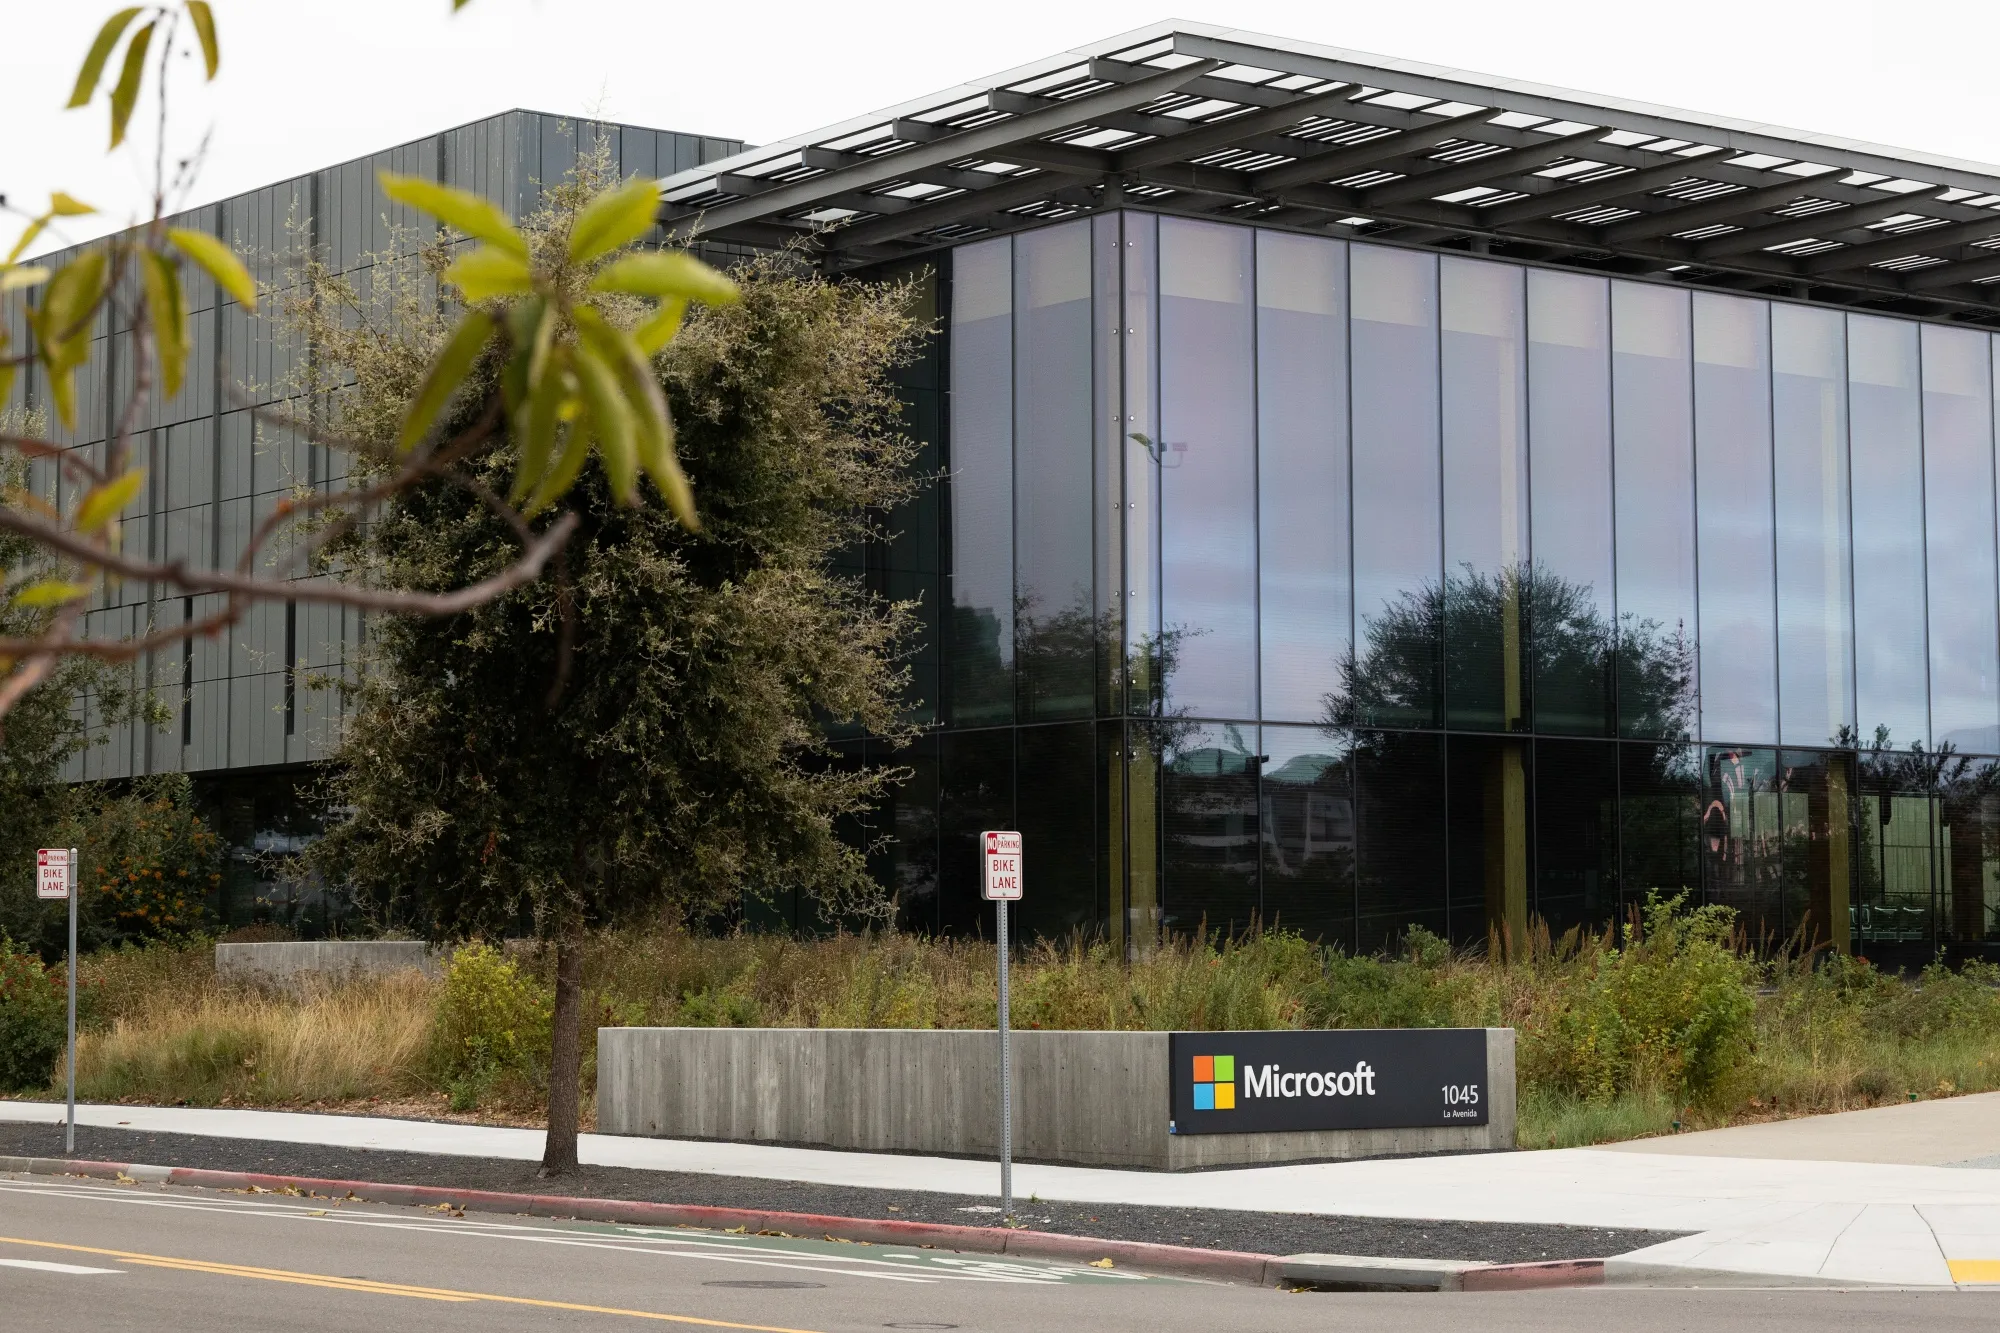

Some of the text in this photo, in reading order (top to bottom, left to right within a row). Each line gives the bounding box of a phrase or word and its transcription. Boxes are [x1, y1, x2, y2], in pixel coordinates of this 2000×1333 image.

[987, 837, 1019, 850] NO PARKING
[39, 853, 47, 862] NO
[993, 859, 1015, 872] BIKE
[44, 869, 63, 878] BIKE
[42, 882, 64, 891] LANE
[992, 877, 1017, 889] LANE
[1244, 1060, 1375, 1098] Microsoft
[1441, 1084, 1479, 1105] 1045
[1443, 1109, 1478, 1118] La Avenida
